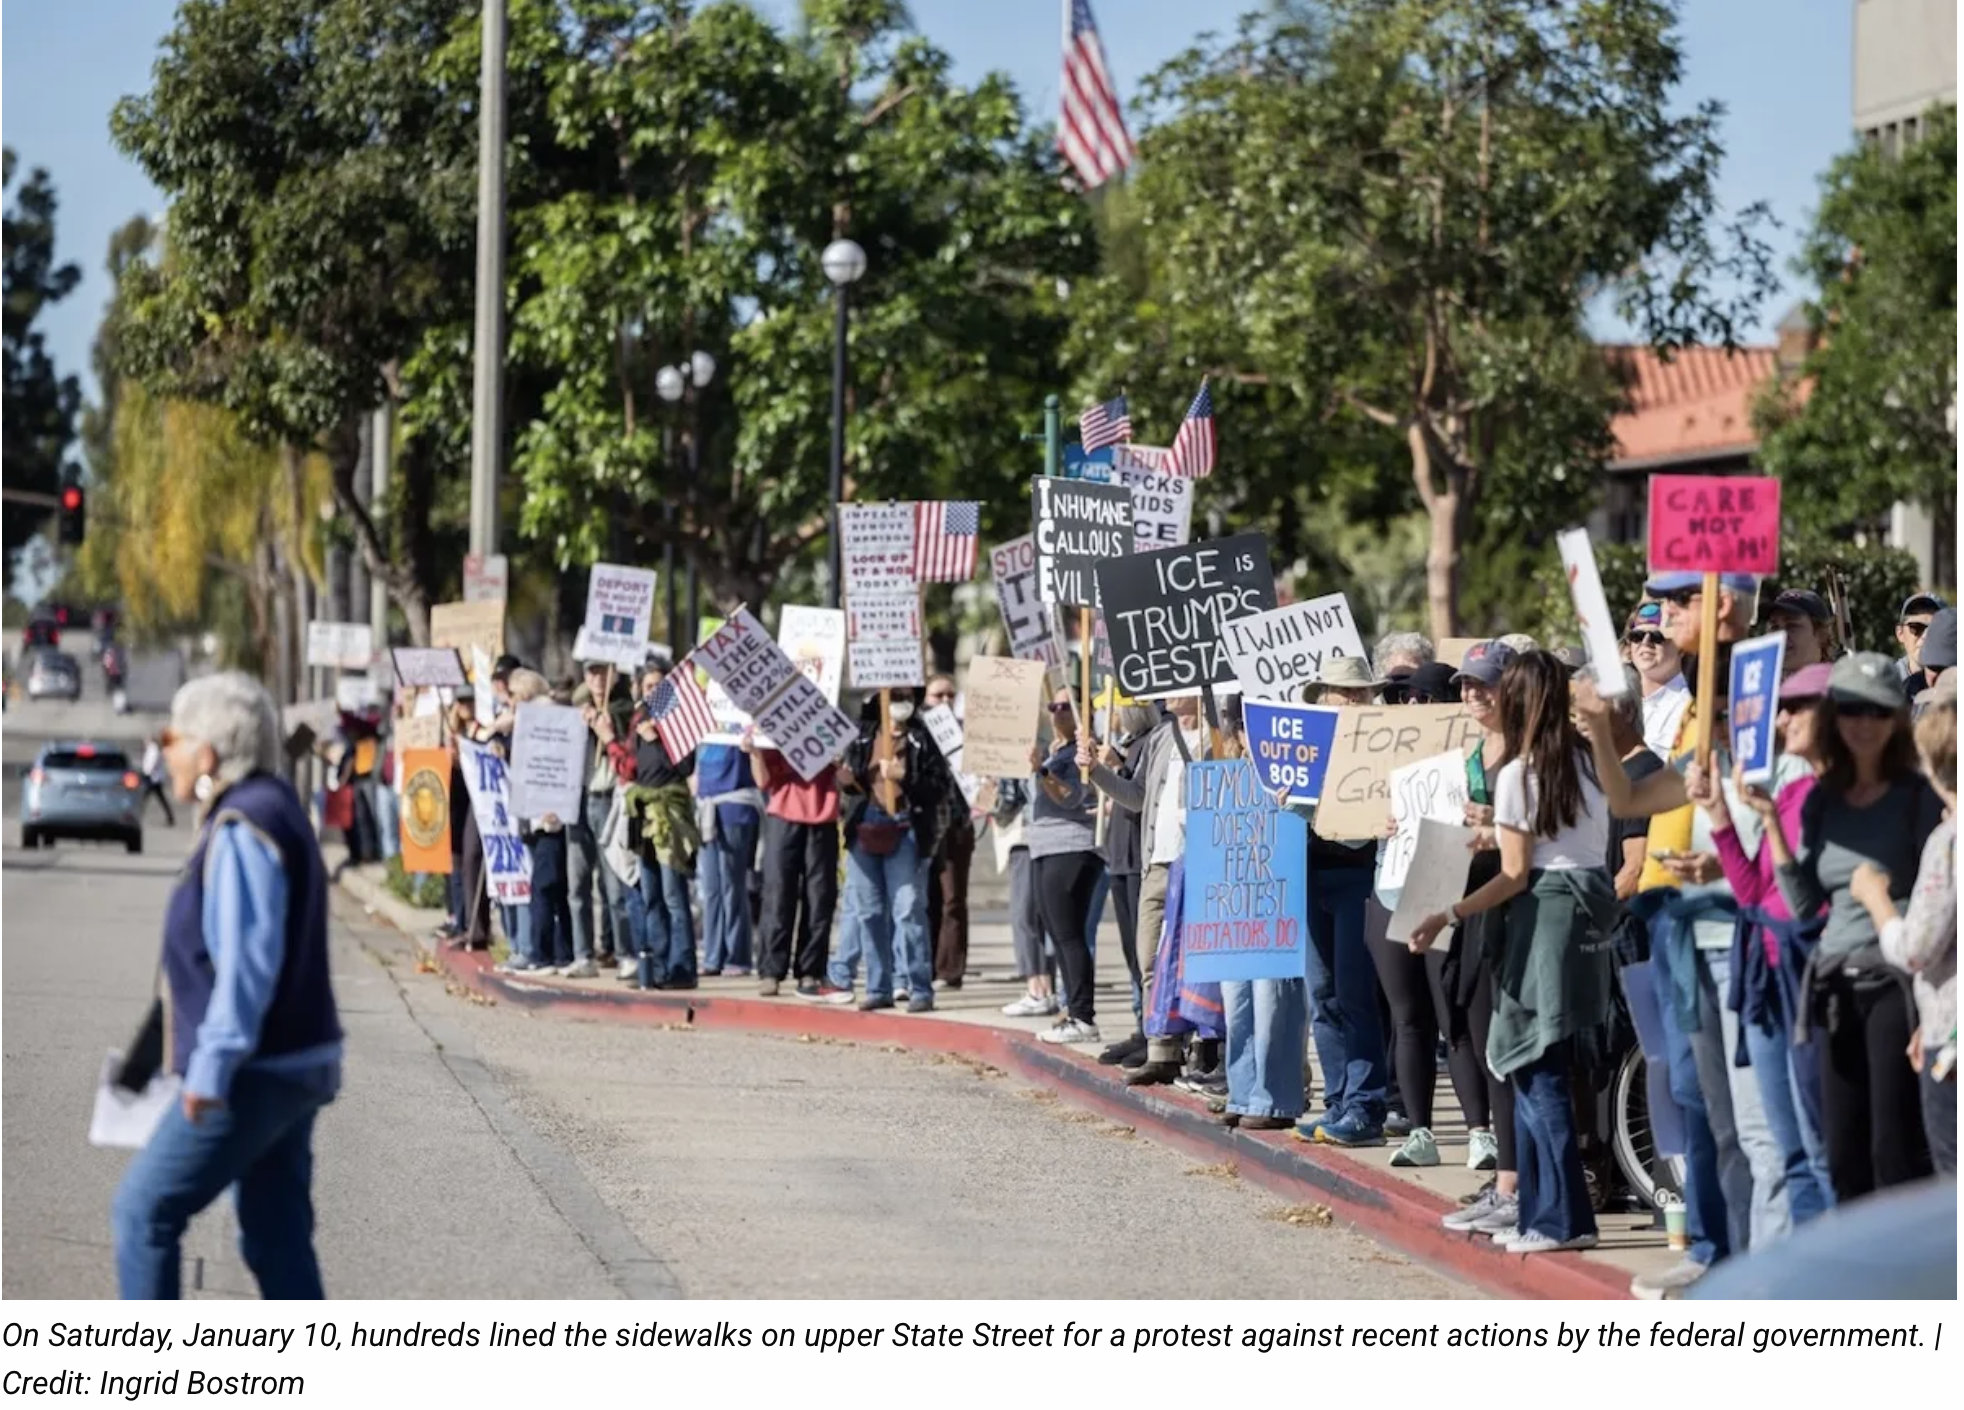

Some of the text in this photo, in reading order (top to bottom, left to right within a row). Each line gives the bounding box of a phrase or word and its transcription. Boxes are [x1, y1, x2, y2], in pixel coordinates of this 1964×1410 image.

[846, 511, 908, 519] IMPEACH
[1037, 479, 1132, 527] INHUMANE
[852, 522, 904, 531] REMOVE
[1038, 519, 1123, 557] CALLOUS
[1133, 520, 1178, 543] CE
[1688, 516, 1744, 535] NOT
[852, 553, 908, 564] LOCK UP
[994, 541, 1034, 577] STO
[1155, 550, 1255, 595] ICE IS
[597, 576, 650, 592] DEPORT
[856, 580, 898, 588] TODAY
[1038, 555, 1089, 605] EVIL
[861, 622, 906, 630] REGIME
[862, 611, 904, 619] ENTIRE
[1116, 585, 1263, 650] TRUMP'S
[703, 615, 748, 661] TAX
[717, 634, 760, 673] THE
[1229, 624, 1248, 656] I
[726, 648, 777, 695] RICH
[1119, 639, 1234, 692] GESTA
[1255, 650, 1322, 684] Obey
[760, 684, 816, 733] STILL
[774, 697, 828, 748] LIVING
[1271, 716, 1304, 740] ICE
[1344, 710, 1483, 753] FOR TH
[1260, 740, 1319, 764] OUT OF
[1269, 763, 1310, 787] 805
[1336, 767, 1391, 804] GR
[1399, 769, 1441, 822] STOP
[1224, 844, 1275, 882] FEAR
[1390, 829, 1415, 877] TR
[1205, 877, 1289, 919] PROTEST
[1187, 916, 1299, 951] DICTATORS DO
